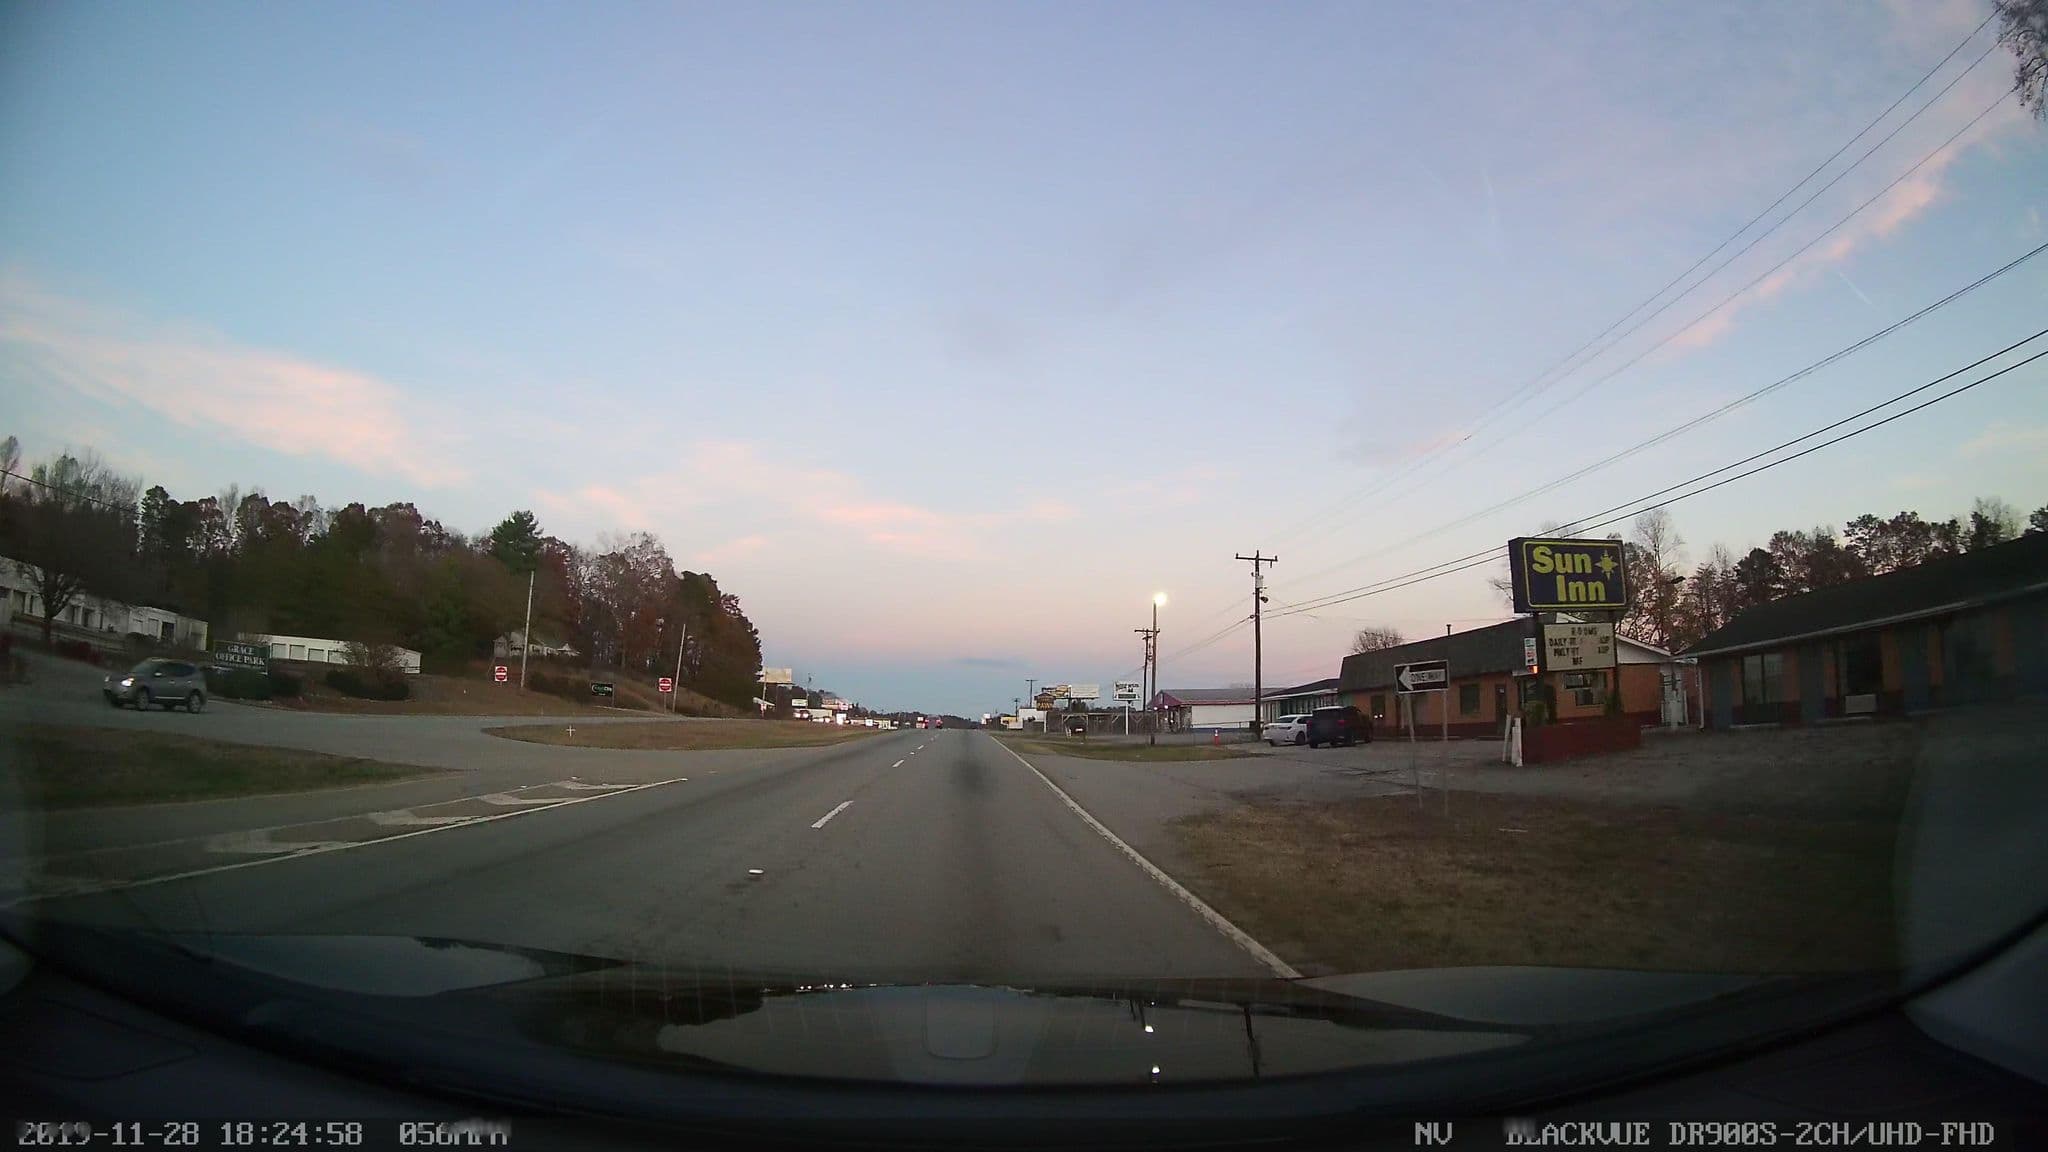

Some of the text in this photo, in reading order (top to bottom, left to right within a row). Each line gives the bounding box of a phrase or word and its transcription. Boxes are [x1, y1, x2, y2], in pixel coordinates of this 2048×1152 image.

[1532, 546, 1593, 574] Sun
[1556, 574, 1606, 602] Inn
[227, 645, 254, 655] GRACE
[215, 652, 265, 665] OFFICE PARK
[1410, 673, 1426, 683] ONE
